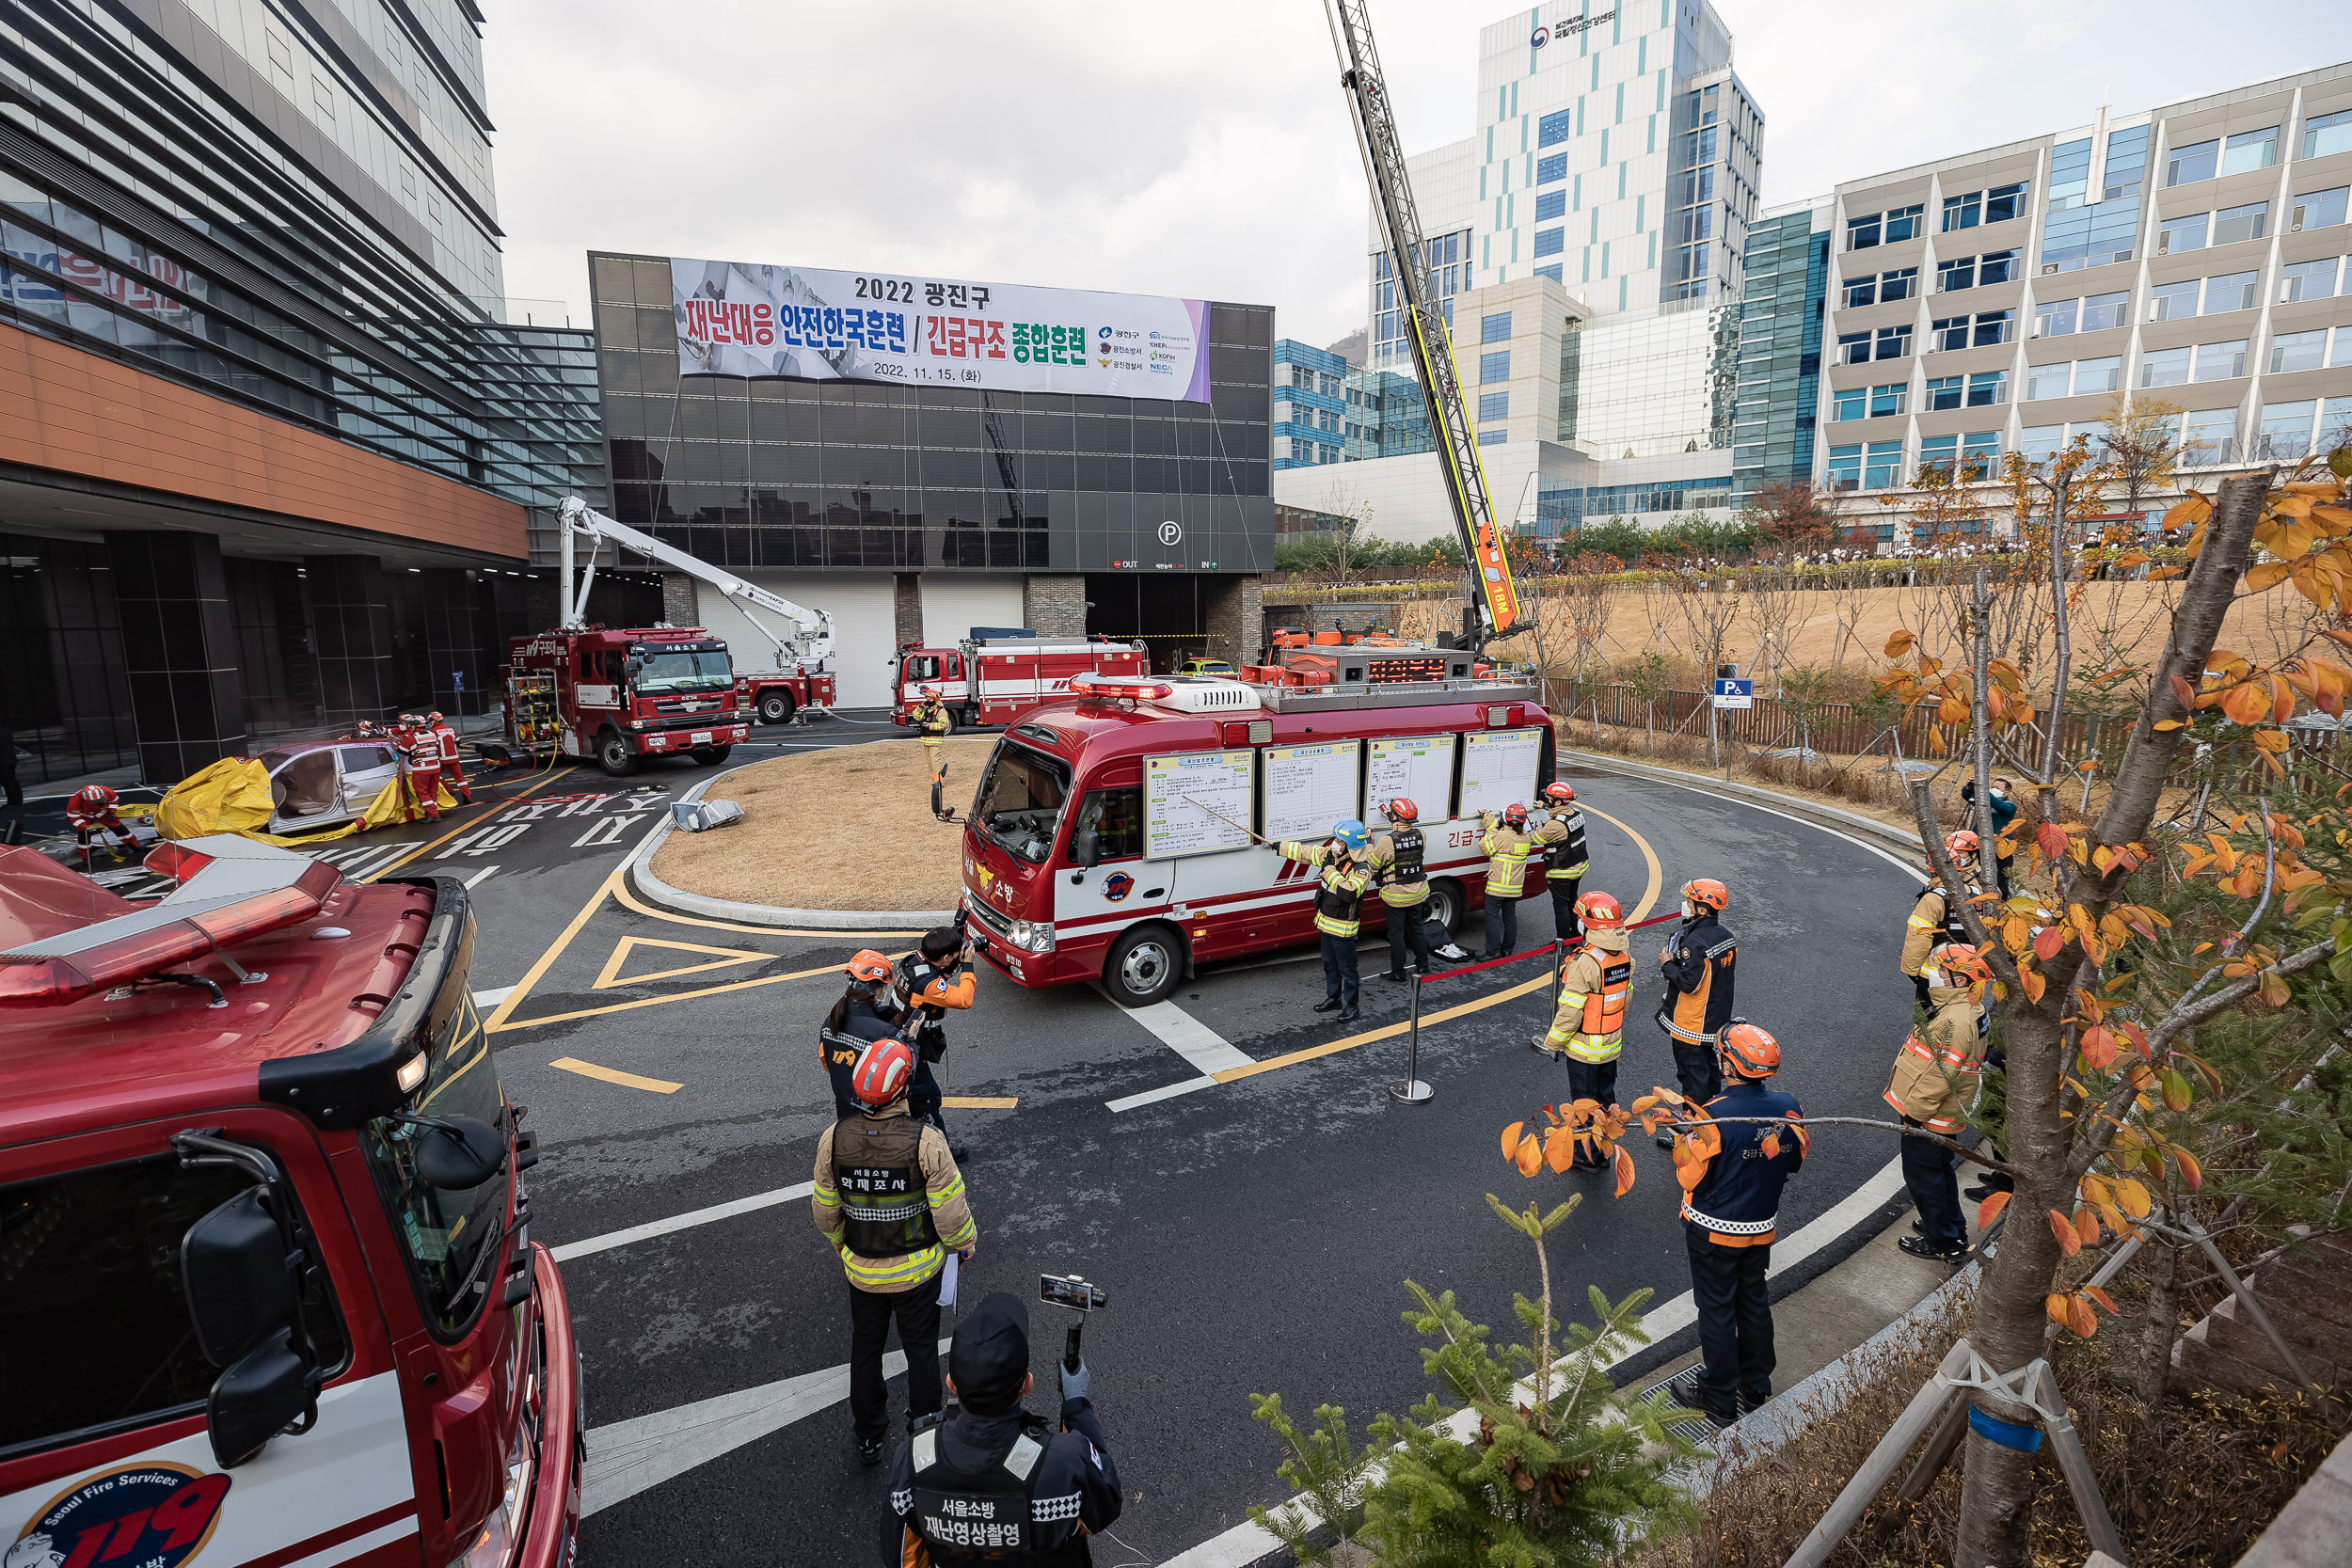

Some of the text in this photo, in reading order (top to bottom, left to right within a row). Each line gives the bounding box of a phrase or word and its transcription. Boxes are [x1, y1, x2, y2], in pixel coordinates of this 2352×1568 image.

[854, 277, 990, 310] 2022 광진구
[685, 299, 774, 346] 재난대응
[780, 304, 906, 355] 안전한국훈련
[927, 315, 1007, 359] 긴급구조
[1012, 322, 1088, 367] 종합훈련
[1115, 329, 1140, 340] 광진구
[1113, 345, 1142, 356] 광진소방서
[874, 362, 982, 384] 2022. 11. 15. (화)
[1165, 525, 1177, 542] P
[1492, 585, 1509, 615] 18M
[1724, 681, 1737, 695] P
[1395, 838, 1422, 850] 화재조사
[964, 855, 1014, 903] 서울 소방
[1005, 953, 1022, 967] 광진10
[853, 1168, 889, 1178] 서울소방
[841, 1177, 906, 1192] 화재조사
[44, 1472, 179, 1526] Seoul Fire Services
[942, 1498, 995, 1519] 서울소방
[60, 1474, 229, 1568] 119
[924, 1515, 1020, 1547] 재난영상촬영
